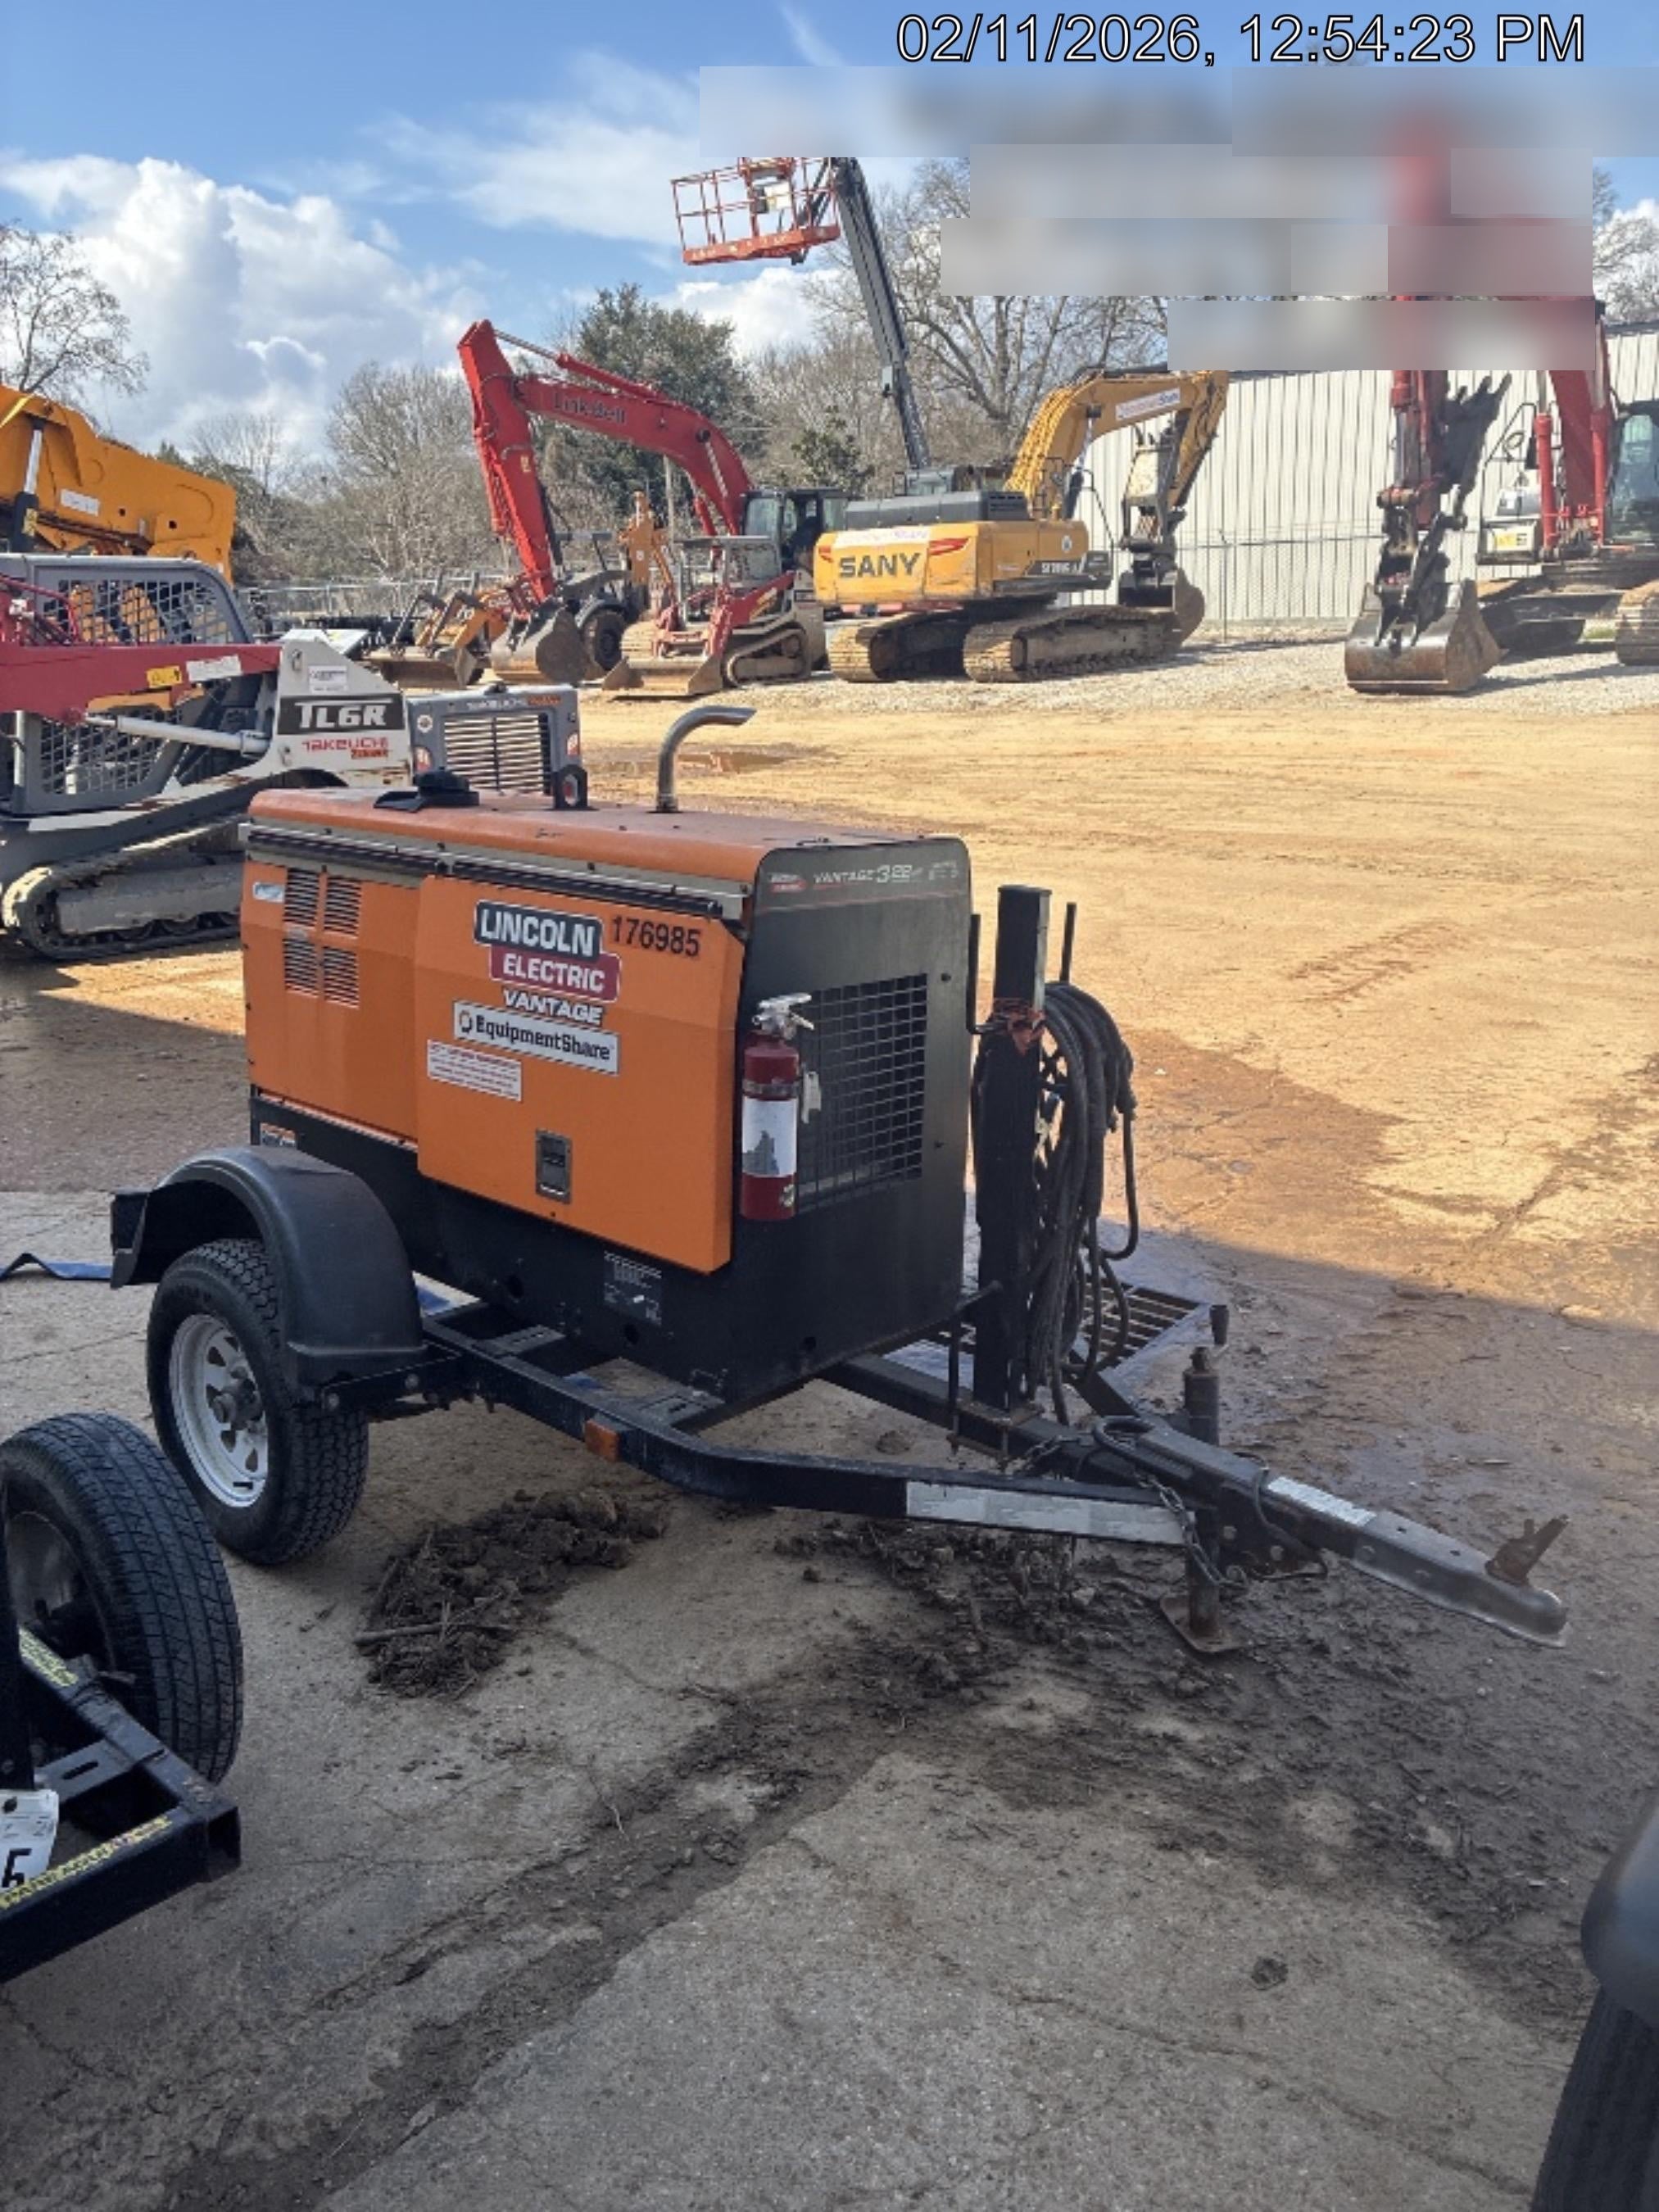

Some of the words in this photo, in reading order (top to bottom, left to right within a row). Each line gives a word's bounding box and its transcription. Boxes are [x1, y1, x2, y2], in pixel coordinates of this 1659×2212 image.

[839, 552, 922, 578] SANY
[294, 700, 390, 729] TL6R
[480, 909, 596, 957] LINCOLN
[612, 915, 701, 958] 176985
[503, 954, 605, 993] ELECTRIC
[503, 989, 604, 1025] VANTAGE
[475, 1014, 610, 1061] EquipmentShare
